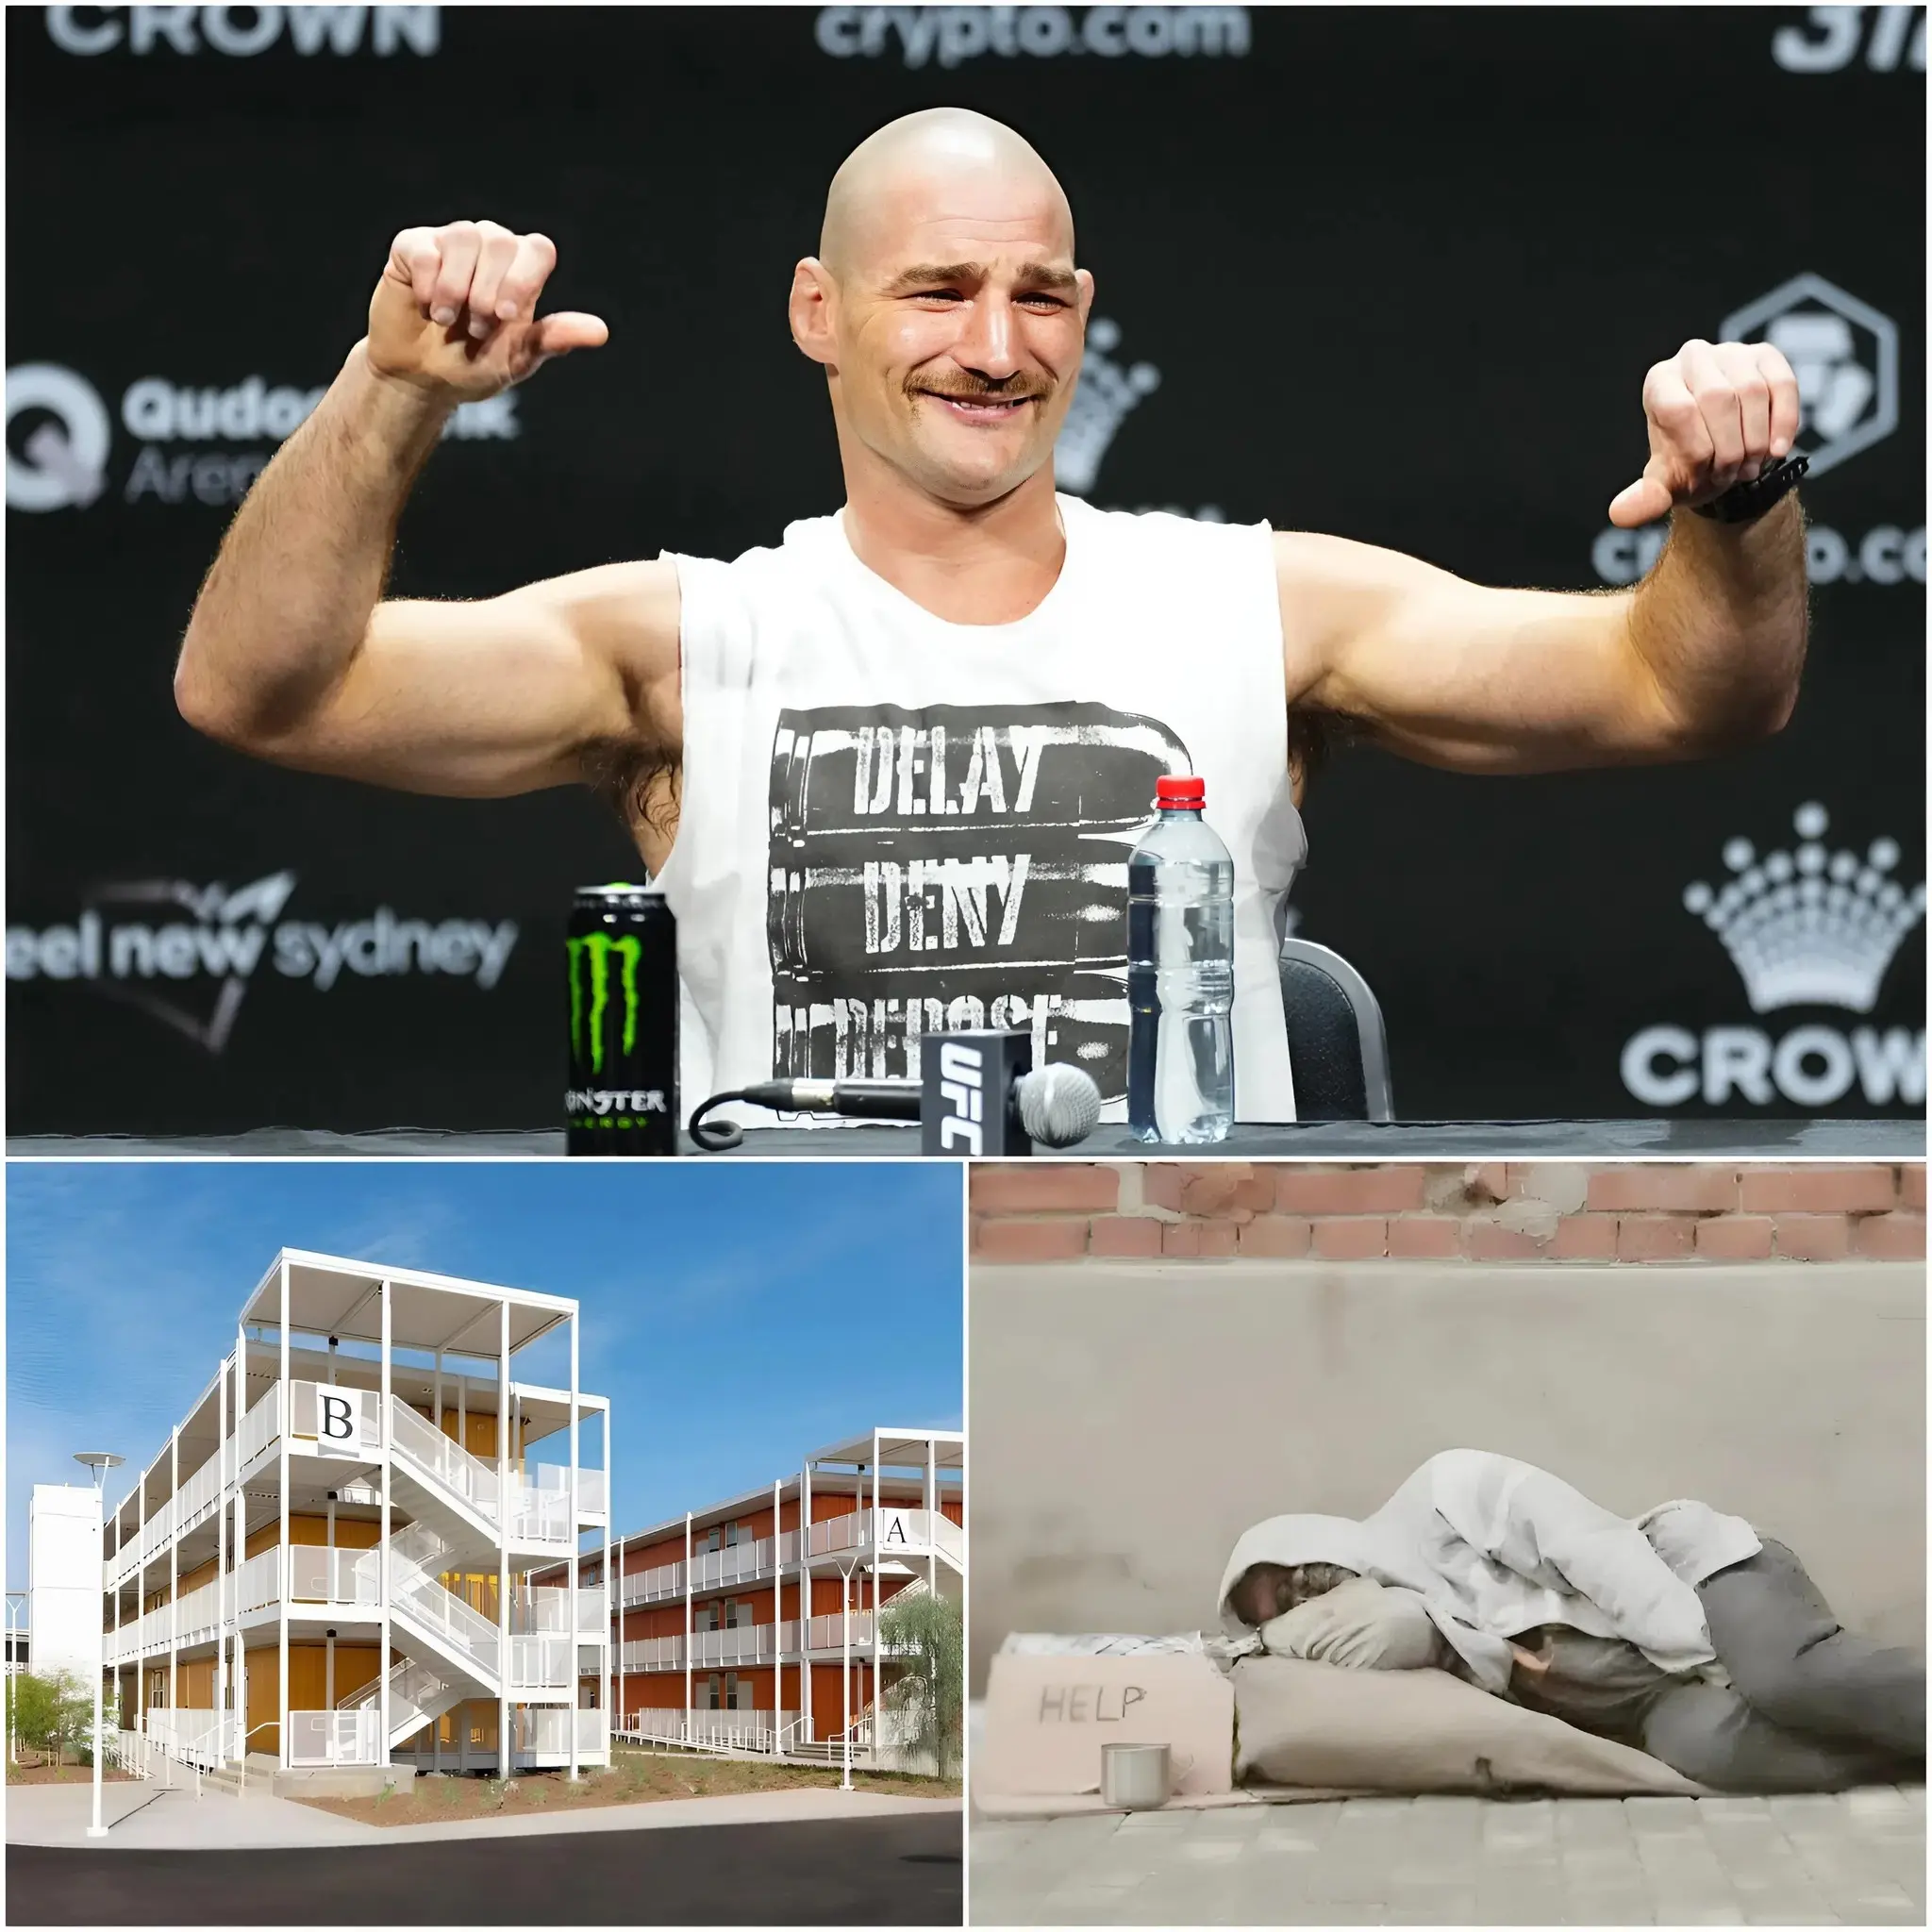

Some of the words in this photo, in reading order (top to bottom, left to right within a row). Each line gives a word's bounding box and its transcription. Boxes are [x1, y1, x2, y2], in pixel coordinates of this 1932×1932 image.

[46, 6, 441, 55] CROWN
[815, 6, 1252, 69] crypto.com
[1772, 6, 1926, 74] 31
[854, 725, 1043, 814] DELAY
[864, 854, 1032, 954] DENY
[109, 923, 267, 978] new
[274, 904, 518, 991] sydney
[941, 1041, 983, 1156] UFC
[319, 1394, 353, 1439] B
[887, 1516, 908, 1543] A
[1041, 1685, 1147, 1724] HELP
